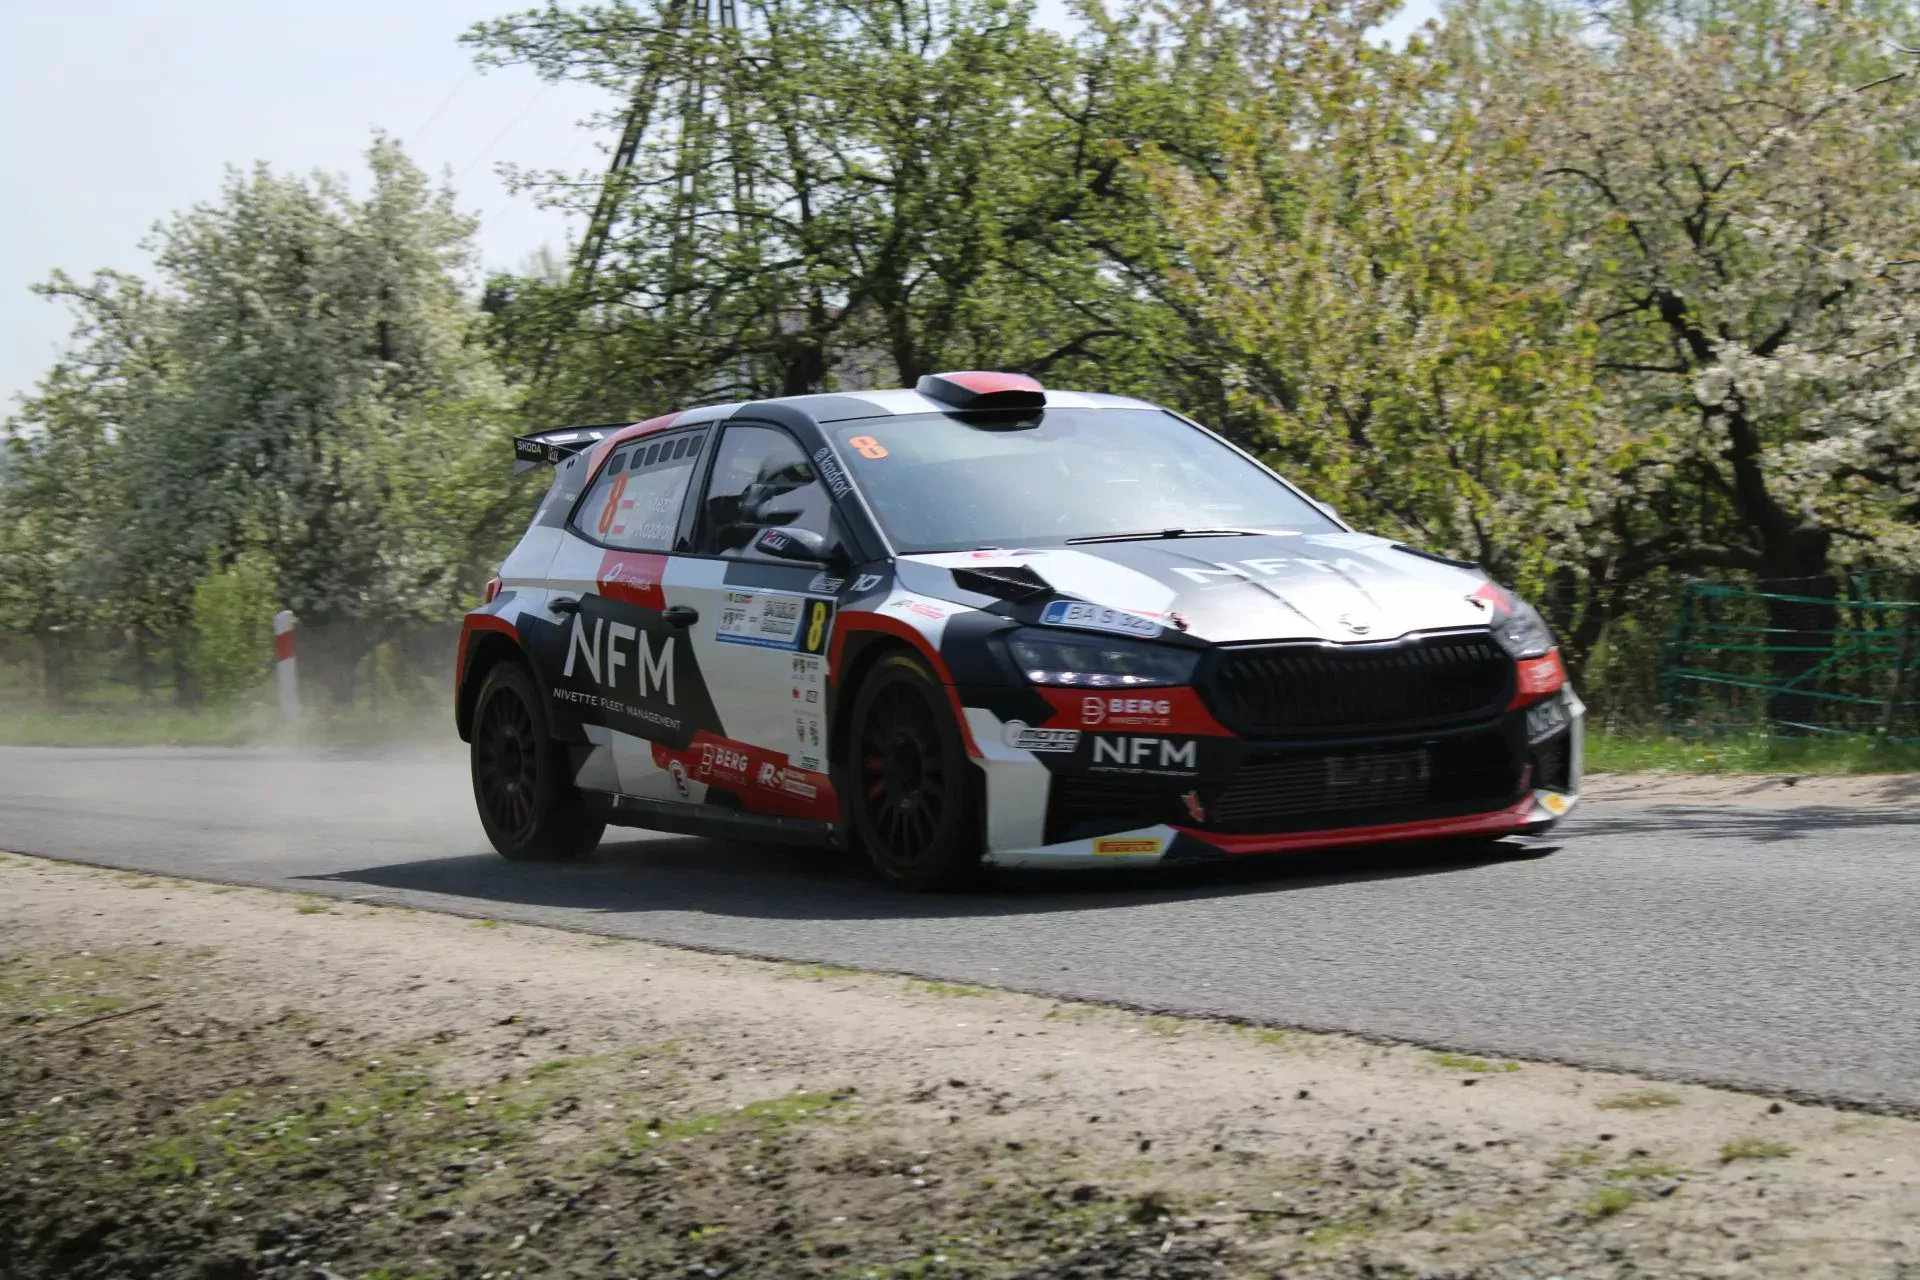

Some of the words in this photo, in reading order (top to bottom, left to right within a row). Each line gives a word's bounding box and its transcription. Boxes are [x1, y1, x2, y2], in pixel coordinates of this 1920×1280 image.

[847, 435, 889, 459] 8
[598, 472, 629, 533] 8
[1168, 557, 1378, 584] NFM
[806, 601, 826, 651] 8
[1067, 606, 1095, 621] BA
[1100, 609, 1113, 624] S
[563, 611, 676, 706] NFM
[553, 687, 598, 706] NIVETTE
[600, 697, 624, 713] FLEET
[626, 705, 681, 731] MANAGEMENT
[1108, 698, 1171, 715] BERG
[714, 747, 749, 773] BERG
[1092, 735, 1197, 768] NFM
